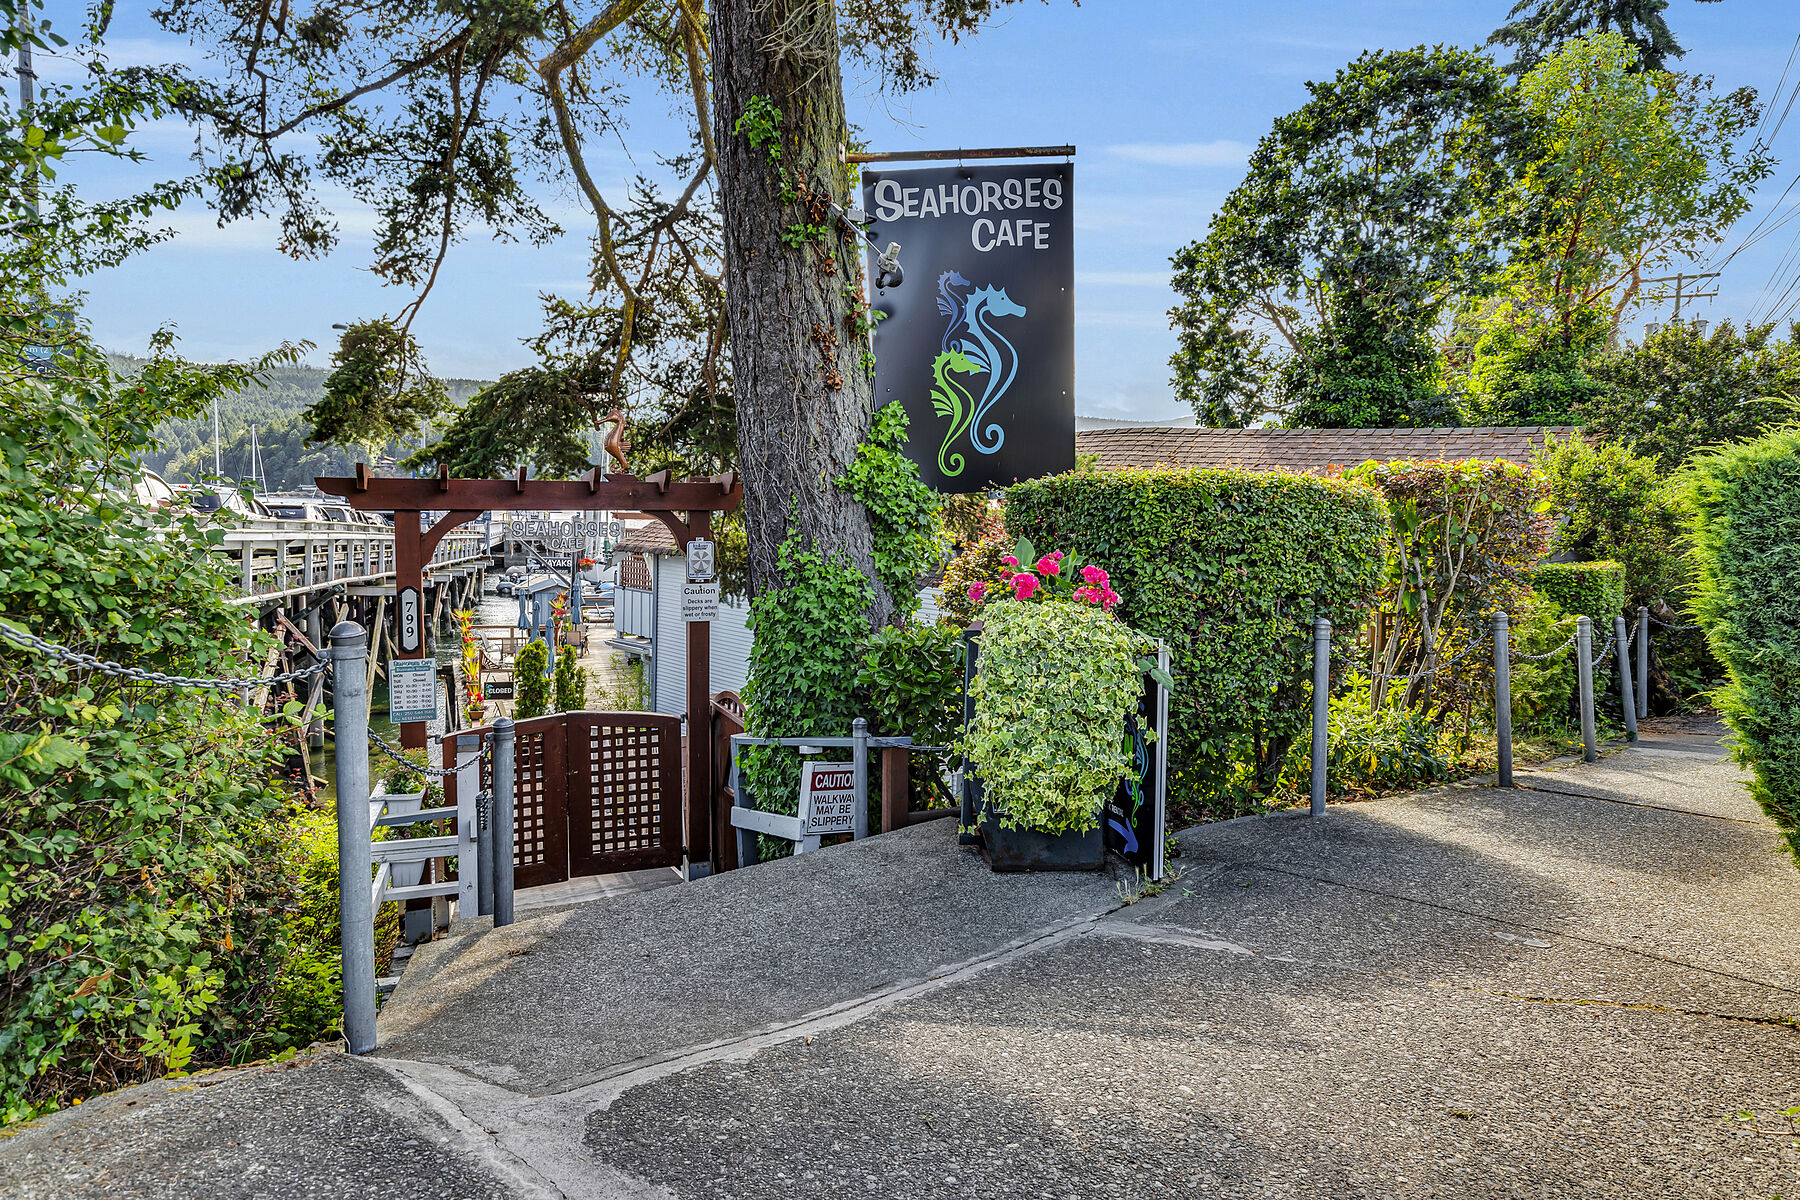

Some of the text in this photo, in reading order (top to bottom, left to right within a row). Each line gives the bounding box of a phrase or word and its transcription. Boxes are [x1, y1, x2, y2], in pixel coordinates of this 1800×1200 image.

[874, 178, 1063, 222] SEAHORSES
[971, 218, 1050, 252] CAFE
[511, 520, 620, 537] SEAHORSES
[551, 537, 584, 549] CAFE
[683, 587, 716, 595] Caution
[405, 601, 414, 638] 799
[816, 804, 851, 815] MAY BE
[811, 815, 854, 827] SLIPPERY
